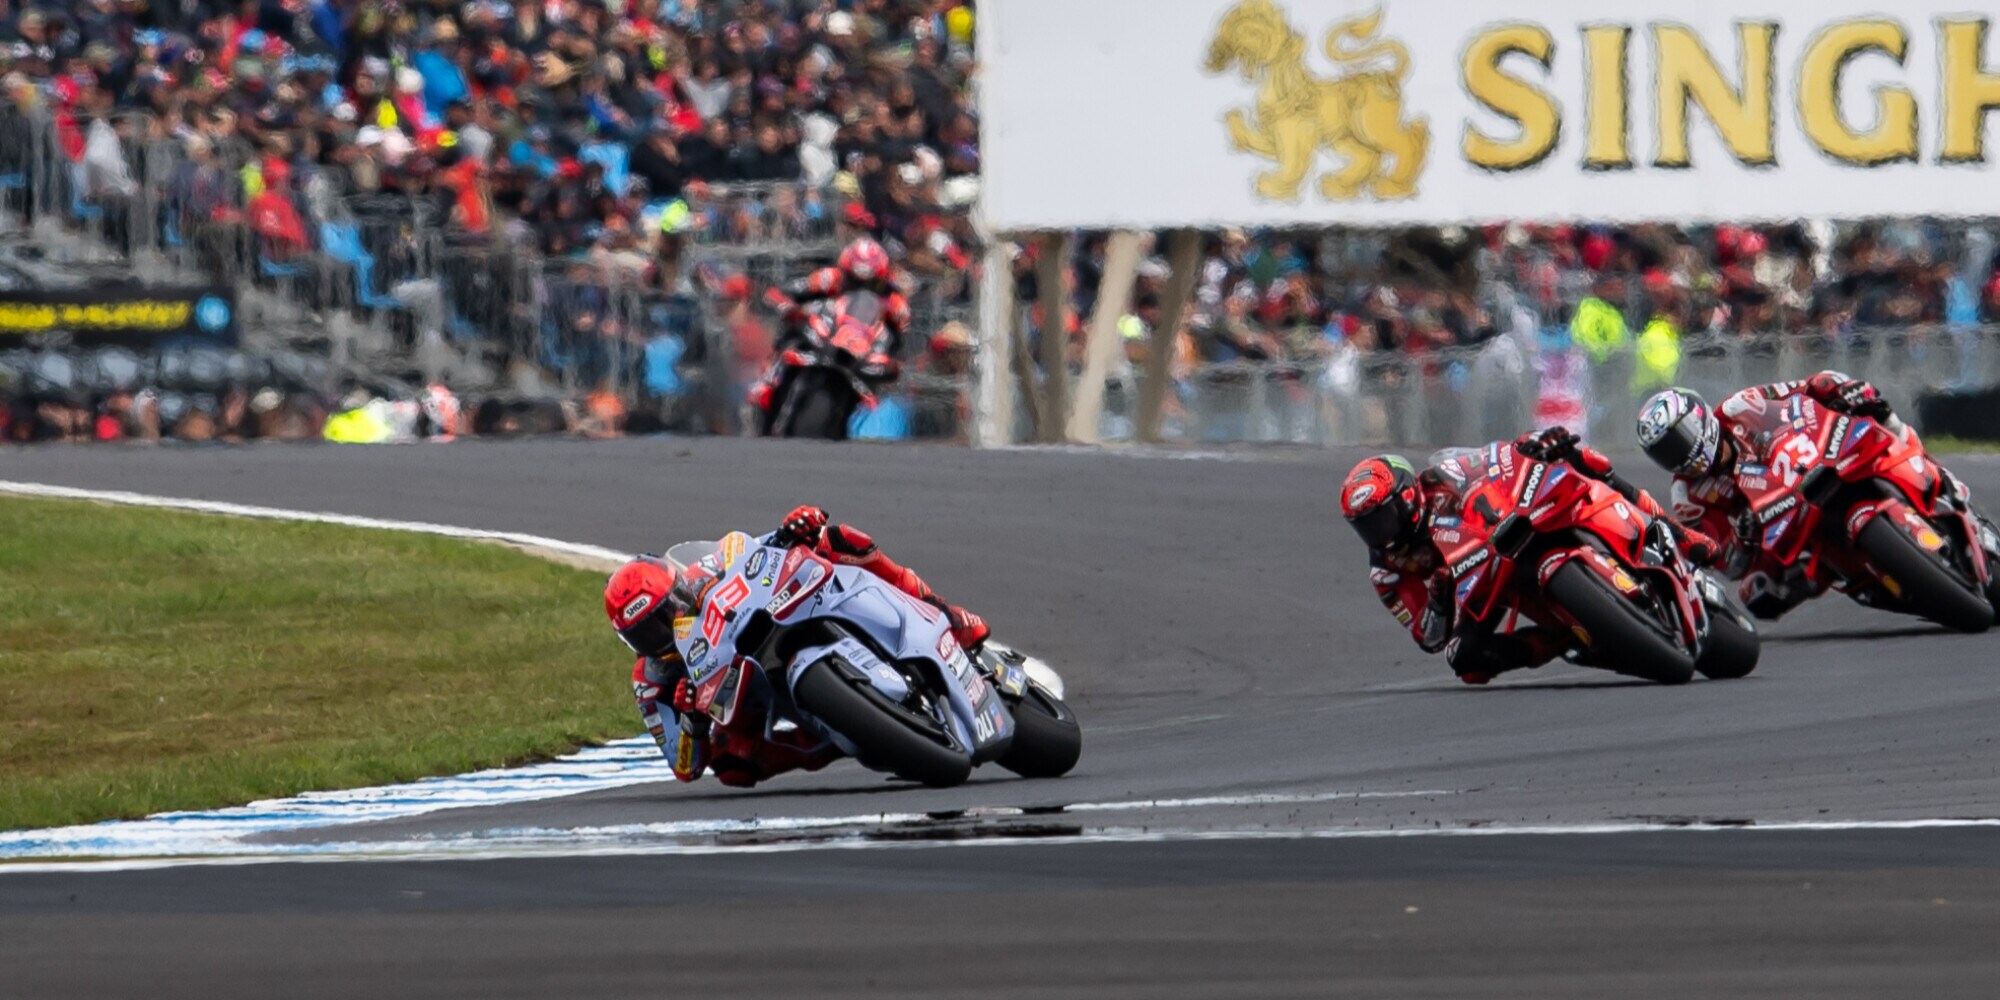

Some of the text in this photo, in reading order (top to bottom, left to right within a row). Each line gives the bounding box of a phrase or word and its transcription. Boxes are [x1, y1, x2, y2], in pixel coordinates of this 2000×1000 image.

[1825, 416, 1850, 459] Lenovo
[1772, 433, 1819, 487] 23
[1519, 463, 1545, 508] Lenovo
[1758, 496, 1796, 524] Lenovo
[1451, 548, 1488, 579] Lenovo
[626, 597, 648, 616] SHOEI
[702, 573, 751, 648] 93
